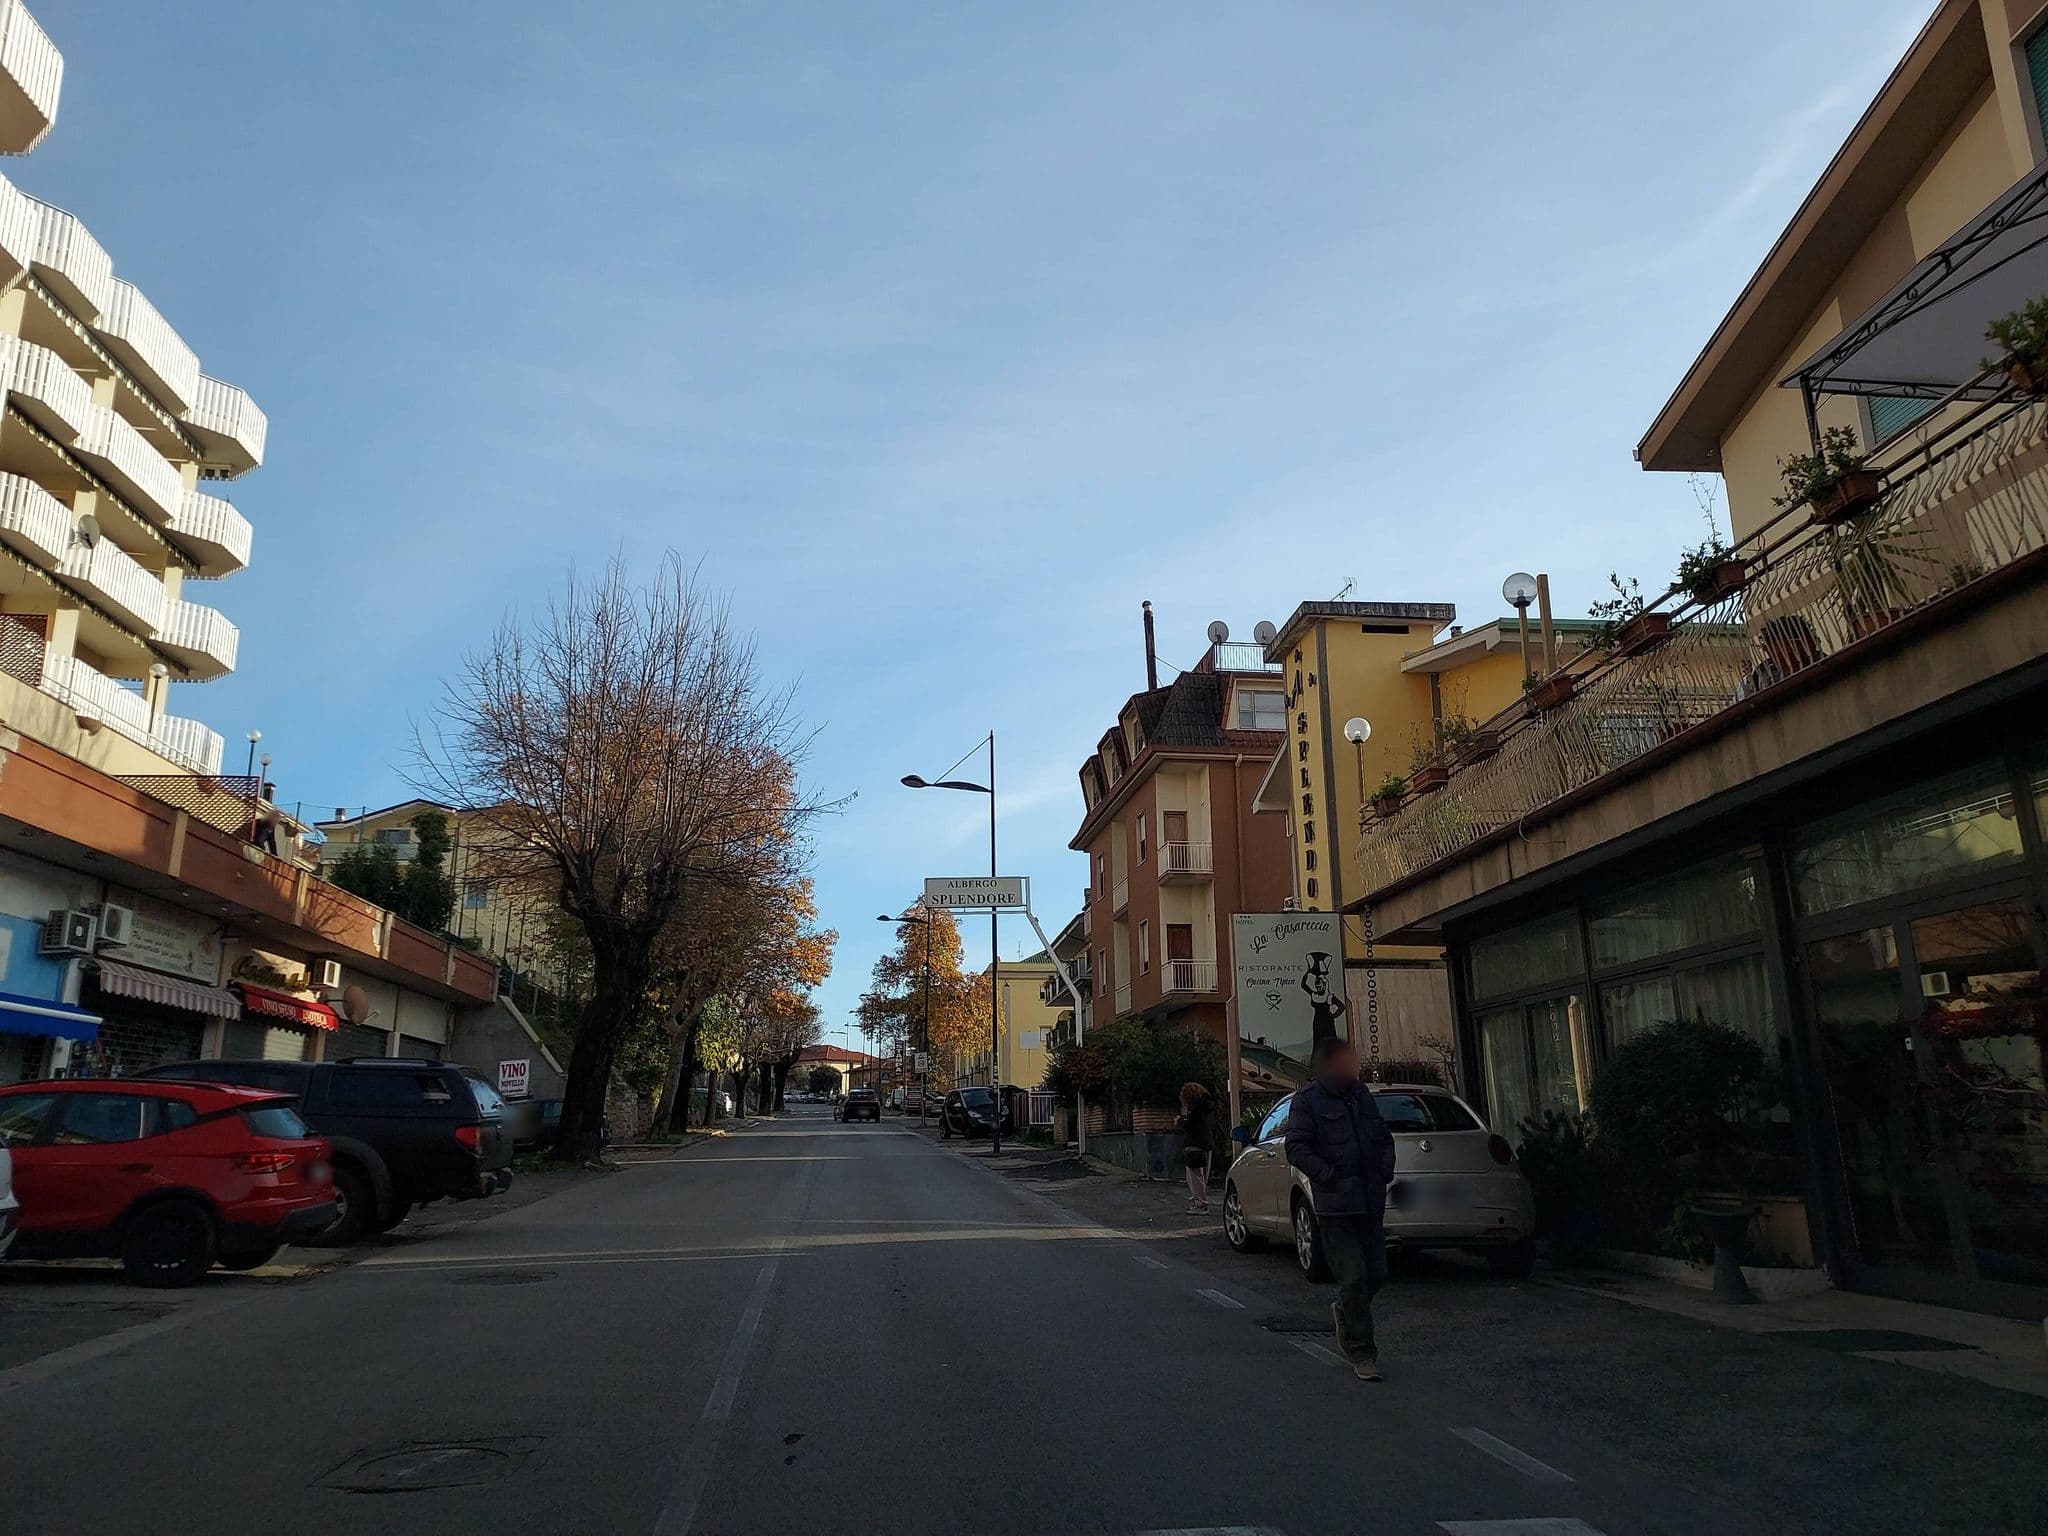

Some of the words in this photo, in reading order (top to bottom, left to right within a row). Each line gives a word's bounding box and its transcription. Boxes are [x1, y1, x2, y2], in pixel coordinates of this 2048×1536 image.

[947, 879, 998, 889] ALBERGO
[931, 893, 1016, 905] SPLENDORE
[1249, 934, 1268, 954] La
[1271, 920, 1330, 940] Casareccia
[1245, 978, 1270, 988] Cucina
[1274, 977, 1296, 988] Tipica
[501, 1063, 526, 1077] VINO
[501, 1079, 525, 1087] NOVELLO
